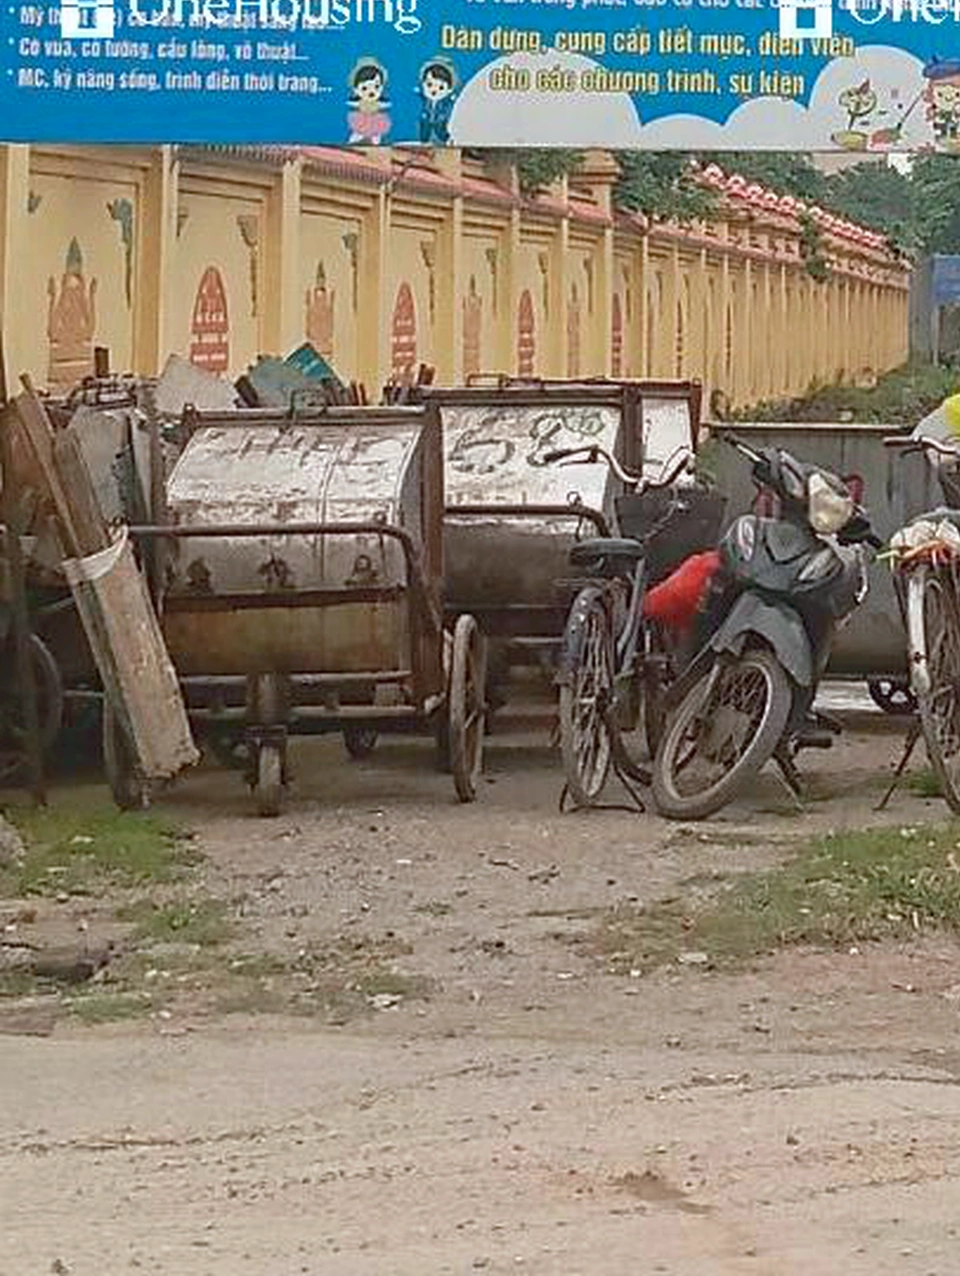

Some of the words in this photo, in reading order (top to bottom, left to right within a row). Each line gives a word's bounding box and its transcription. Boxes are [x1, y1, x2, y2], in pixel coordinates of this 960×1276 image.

[555, 33, 606, 54] cung
[77, 70, 115, 91] năng
[491, 66, 529, 89] cho
[537, 67, 577, 90] các
